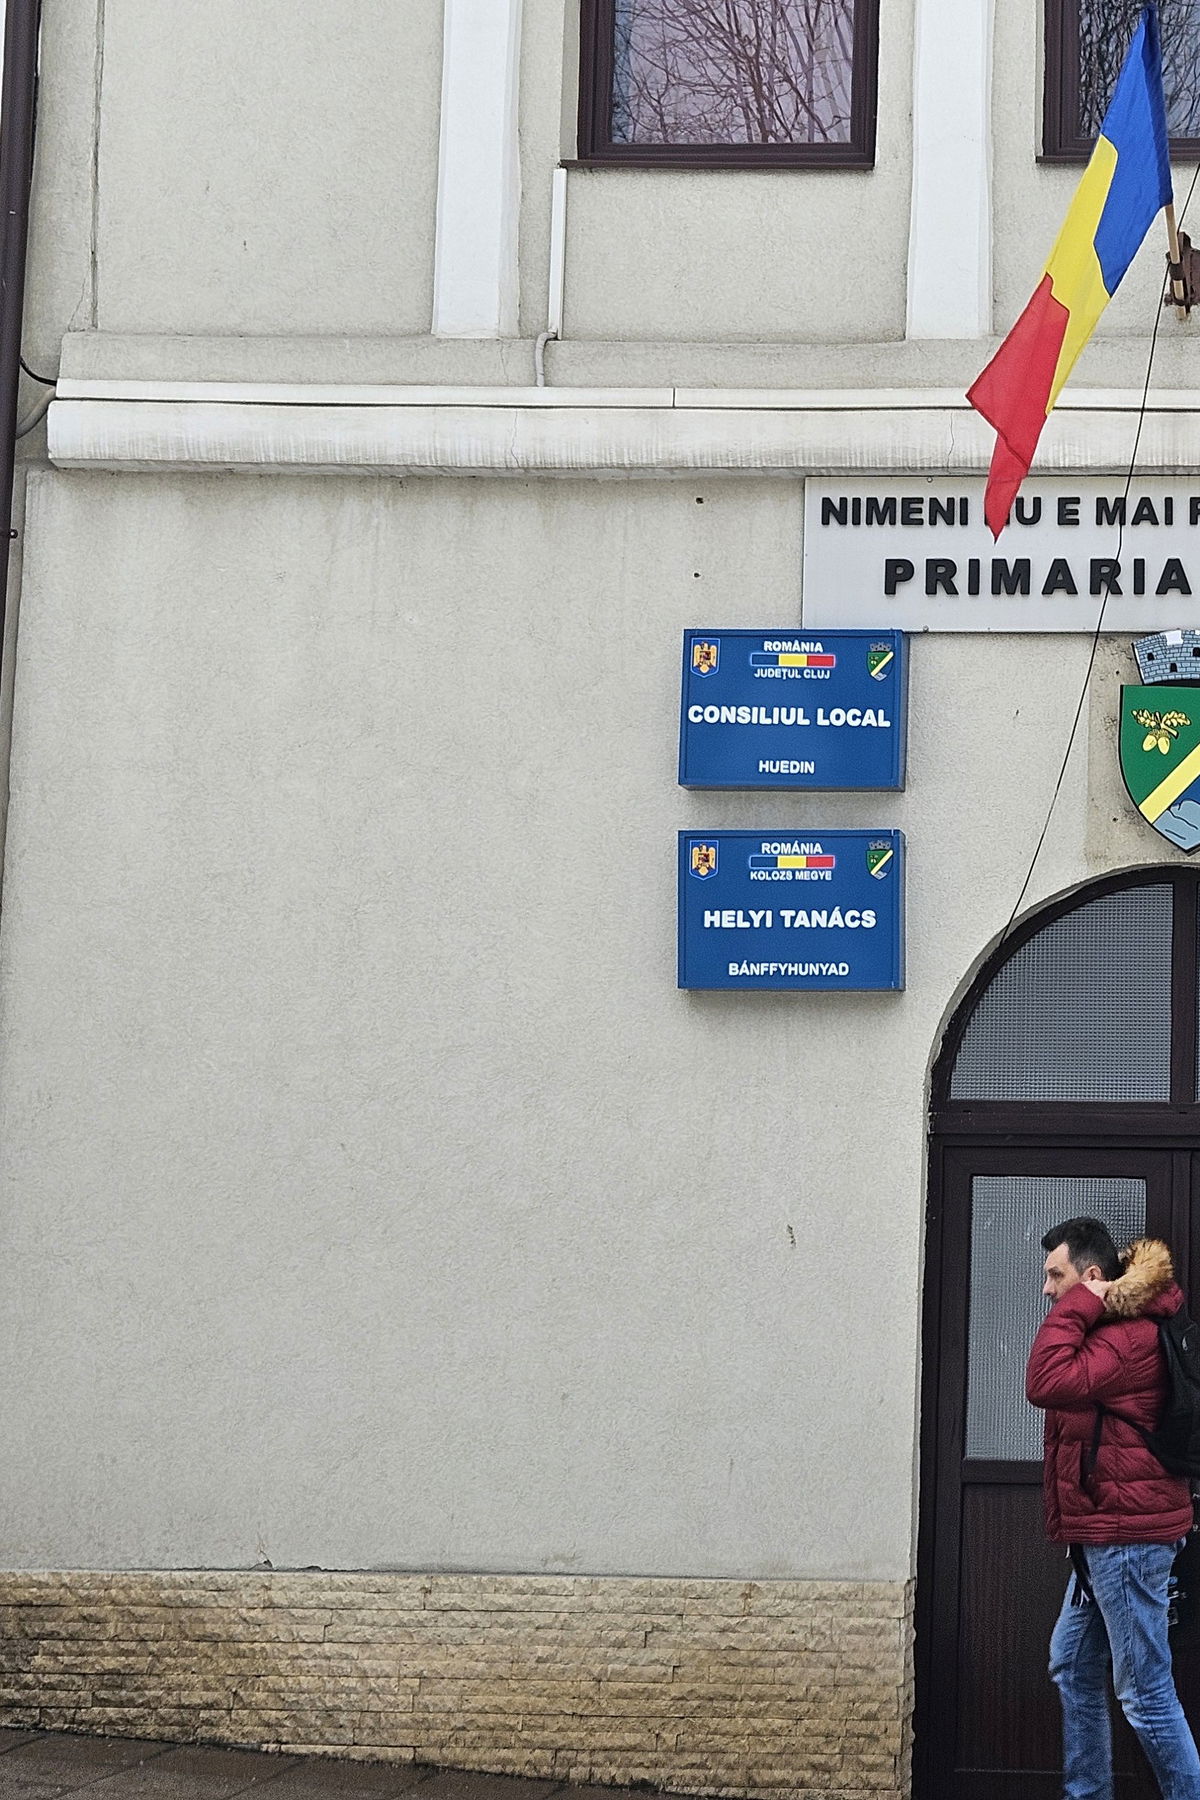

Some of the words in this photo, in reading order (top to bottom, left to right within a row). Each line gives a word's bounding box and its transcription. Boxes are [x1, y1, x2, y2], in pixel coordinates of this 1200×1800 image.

[821, 496, 969, 526] NIMENI
[984, 496, 1042, 526] U
[1057, 496, 1081, 526] E
[1095, 496, 1174, 526] MAI
[884, 557, 1193, 596] PRIMARIA
[763, 639, 824, 653] ROMÂNIA
[803, 668, 831, 680] CLUJ
[687, 704, 811, 726] CONSILIUL
[816, 707, 892, 728] LOCAL
[758, 760, 815, 775] HUEDIN
[761, 840, 823, 854] ROMÁNIA
[750, 870, 794, 881] KOLOZS
[794, 871, 833, 881] MEGYE
[703, 909, 773, 929] HELYI
[780, 906, 877, 929] TANÁCS
[728, 959, 850, 977] BÁNFFYHUNYAD
